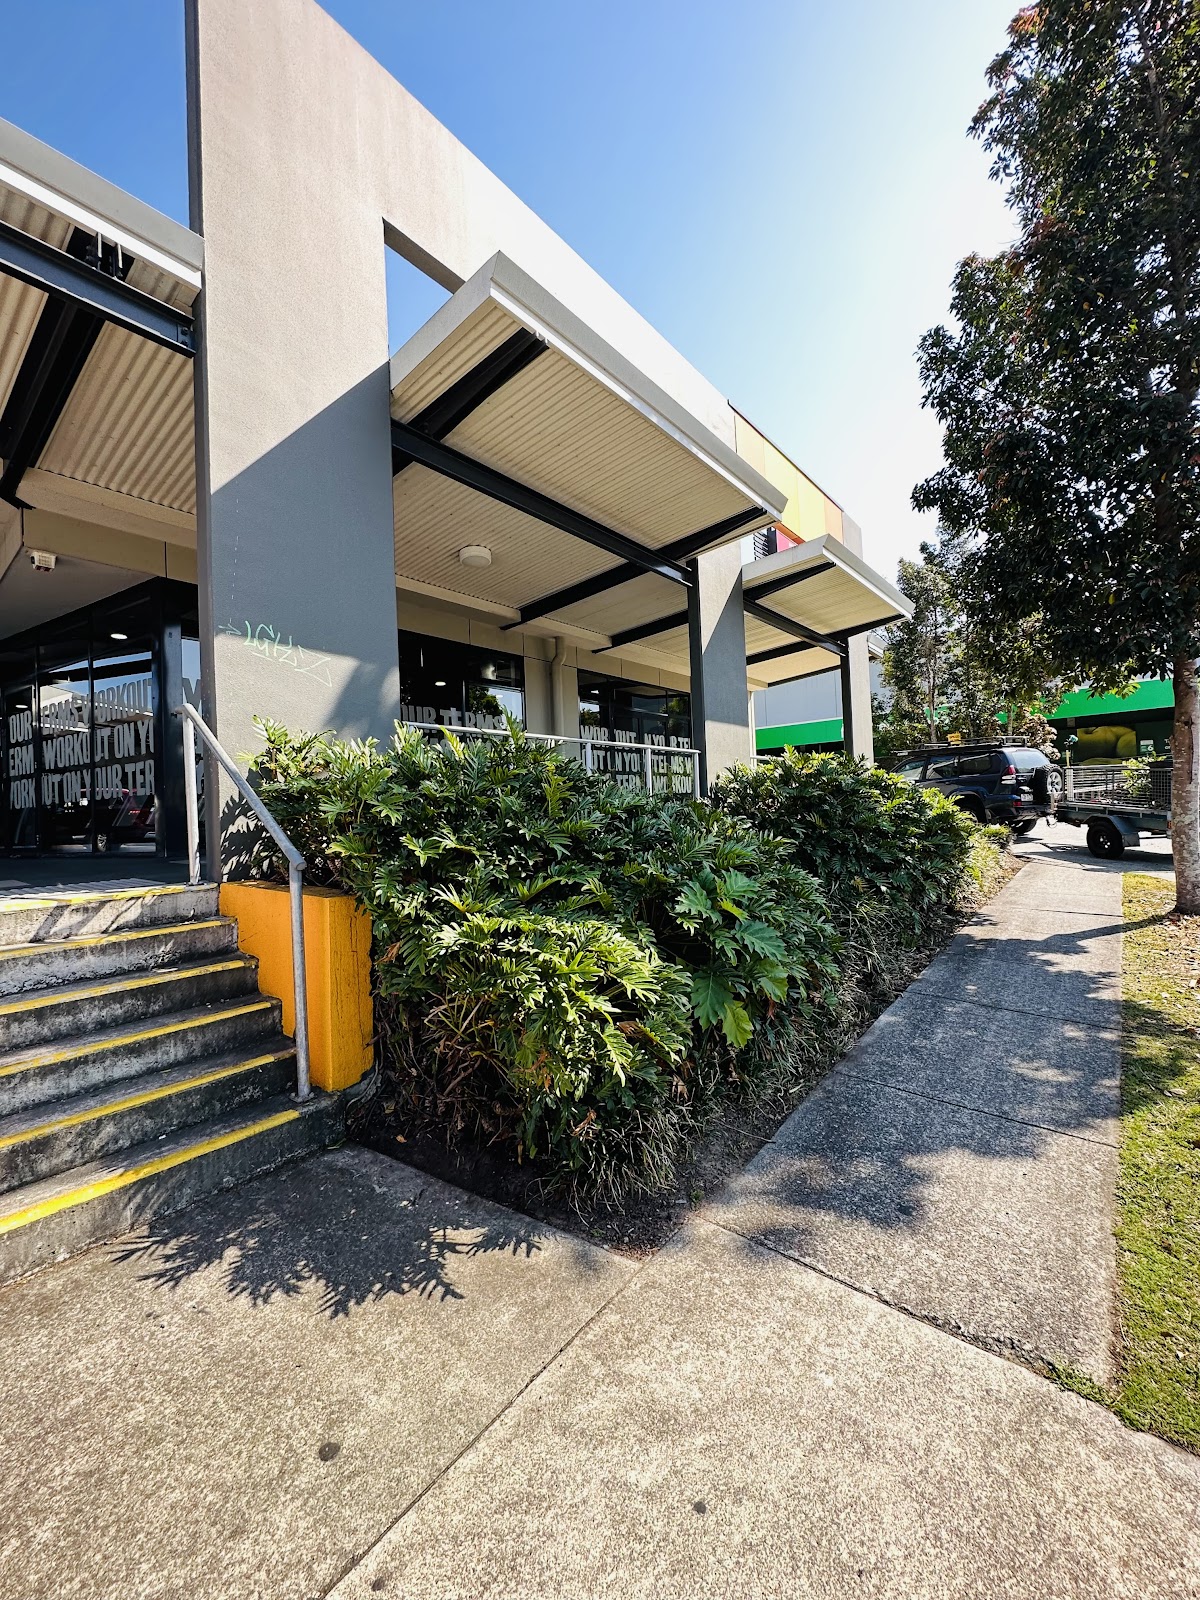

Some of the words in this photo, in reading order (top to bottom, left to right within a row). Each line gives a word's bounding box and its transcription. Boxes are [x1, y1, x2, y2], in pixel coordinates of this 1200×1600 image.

[9, 710, 33, 744] OUR
[41, 694, 79, 736] ERMS
[580, 725, 637, 750] WOROUT
[652, 734, 679, 753] YOR
[9, 743, 37, 777] ERM
[43, 731, 111, 770] WORKOUT
[114, 722, 135, 759] ON
[63, 771, 80, 803] ON
[82, 763, 122, 801] YOUR
[125, 760, 155, 796] TER
